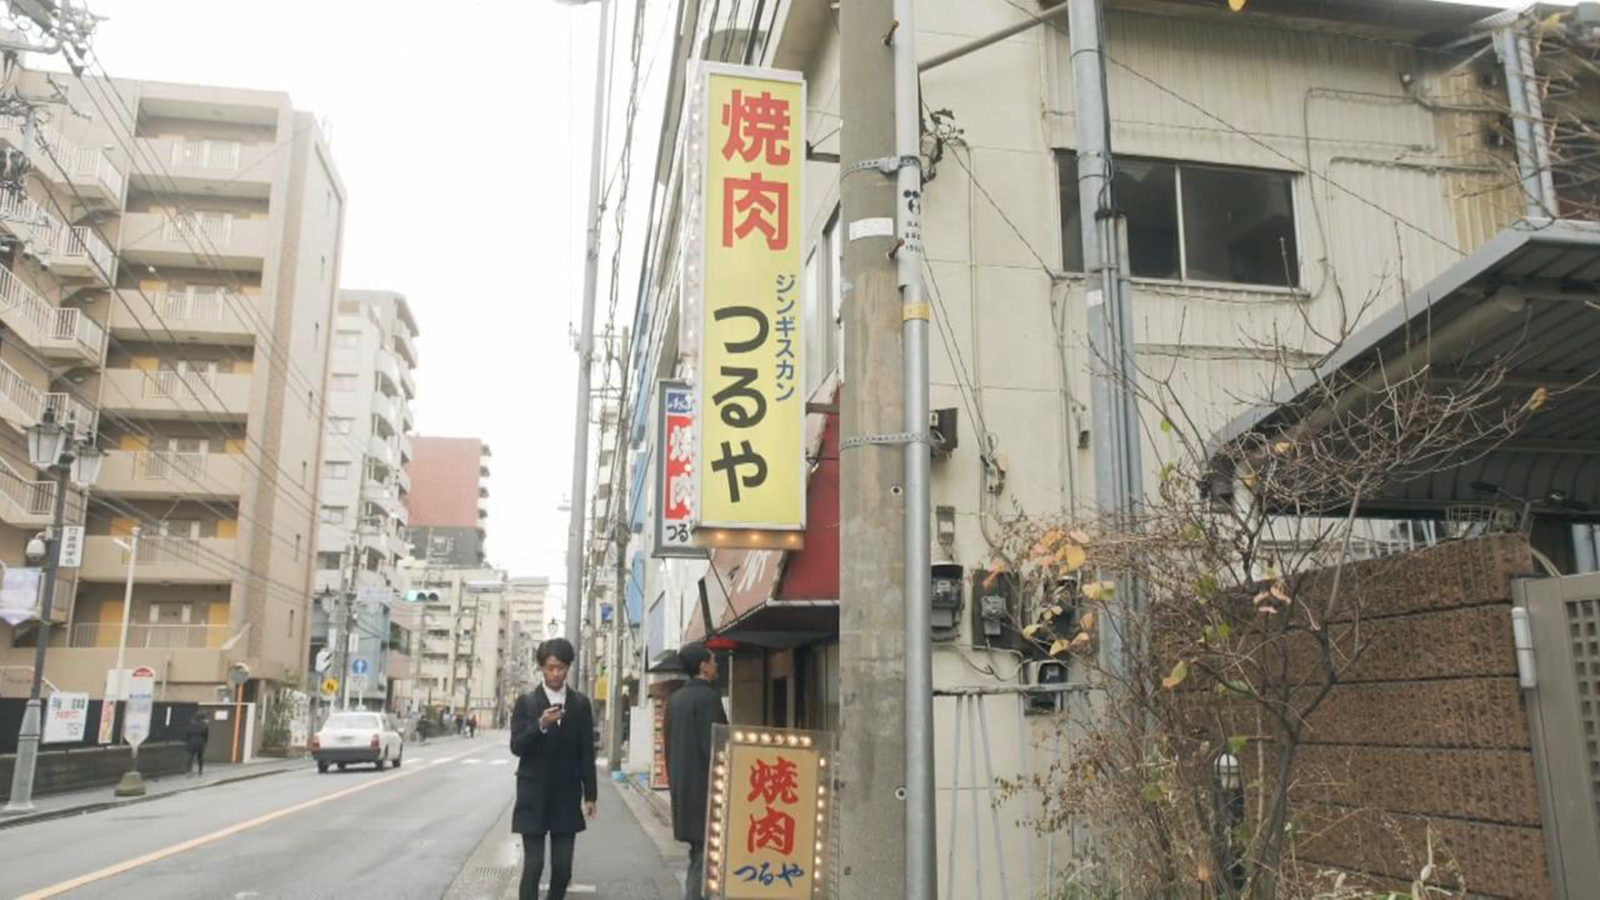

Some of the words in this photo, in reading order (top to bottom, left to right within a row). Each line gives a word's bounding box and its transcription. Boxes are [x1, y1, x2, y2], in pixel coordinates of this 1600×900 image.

[722, 90, 790, 250] 焼肉
[774, 273, 796, 402] ジンギスカン
[712, 306, 769, 502] つるや
[747, 756, 800, 855] 焼肉
[735, 862, 804, 888] つるや
